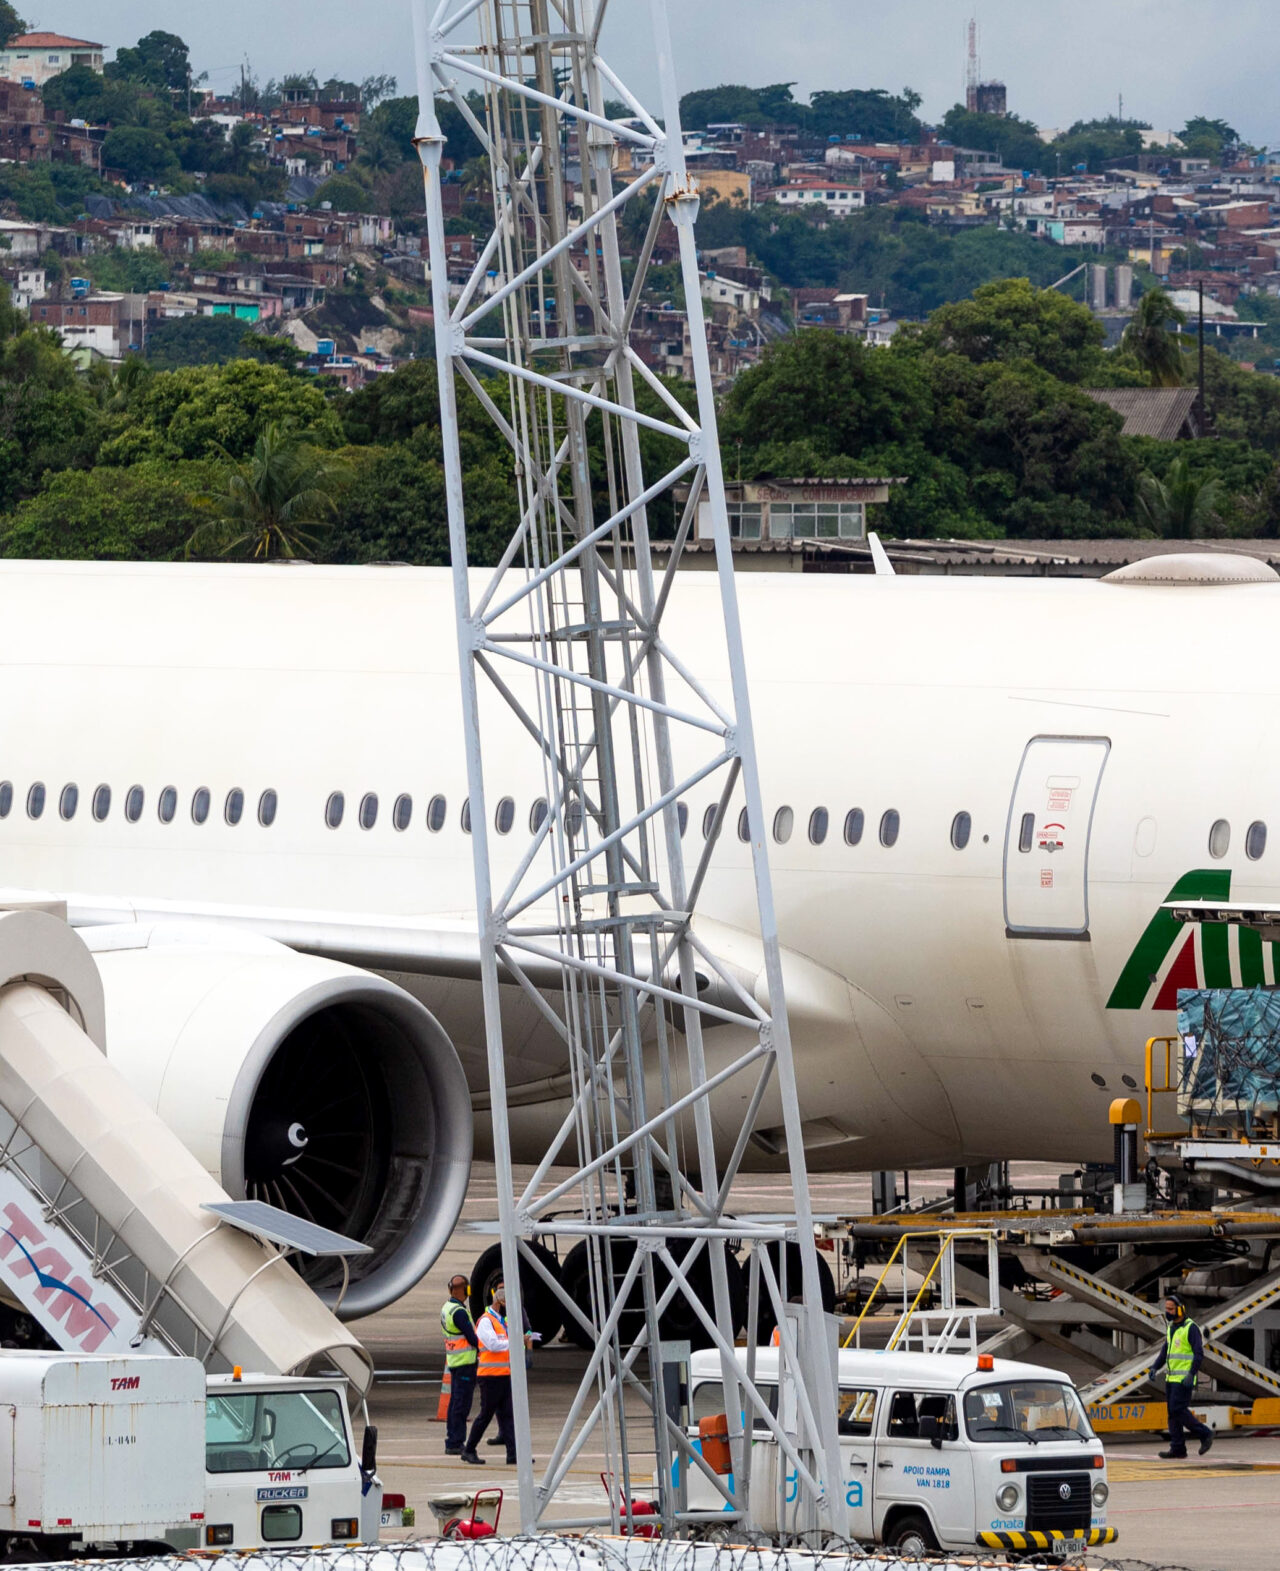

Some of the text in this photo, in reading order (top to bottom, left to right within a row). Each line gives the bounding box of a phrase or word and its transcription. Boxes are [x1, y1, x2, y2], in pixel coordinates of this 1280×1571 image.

[0, 1202, 120, 1353] TAM
[110, 1376, 141, 1391] TAM
[1090, 1405, 1146, 1420] MDL 1747
[903, 1465, 950, 1476] APOIO RAMPA
[268, 1472, 291, 1482] TAM
[916, 1478, 931, 1487] VAN
[990, 1518, 1024, 1530] dnata
